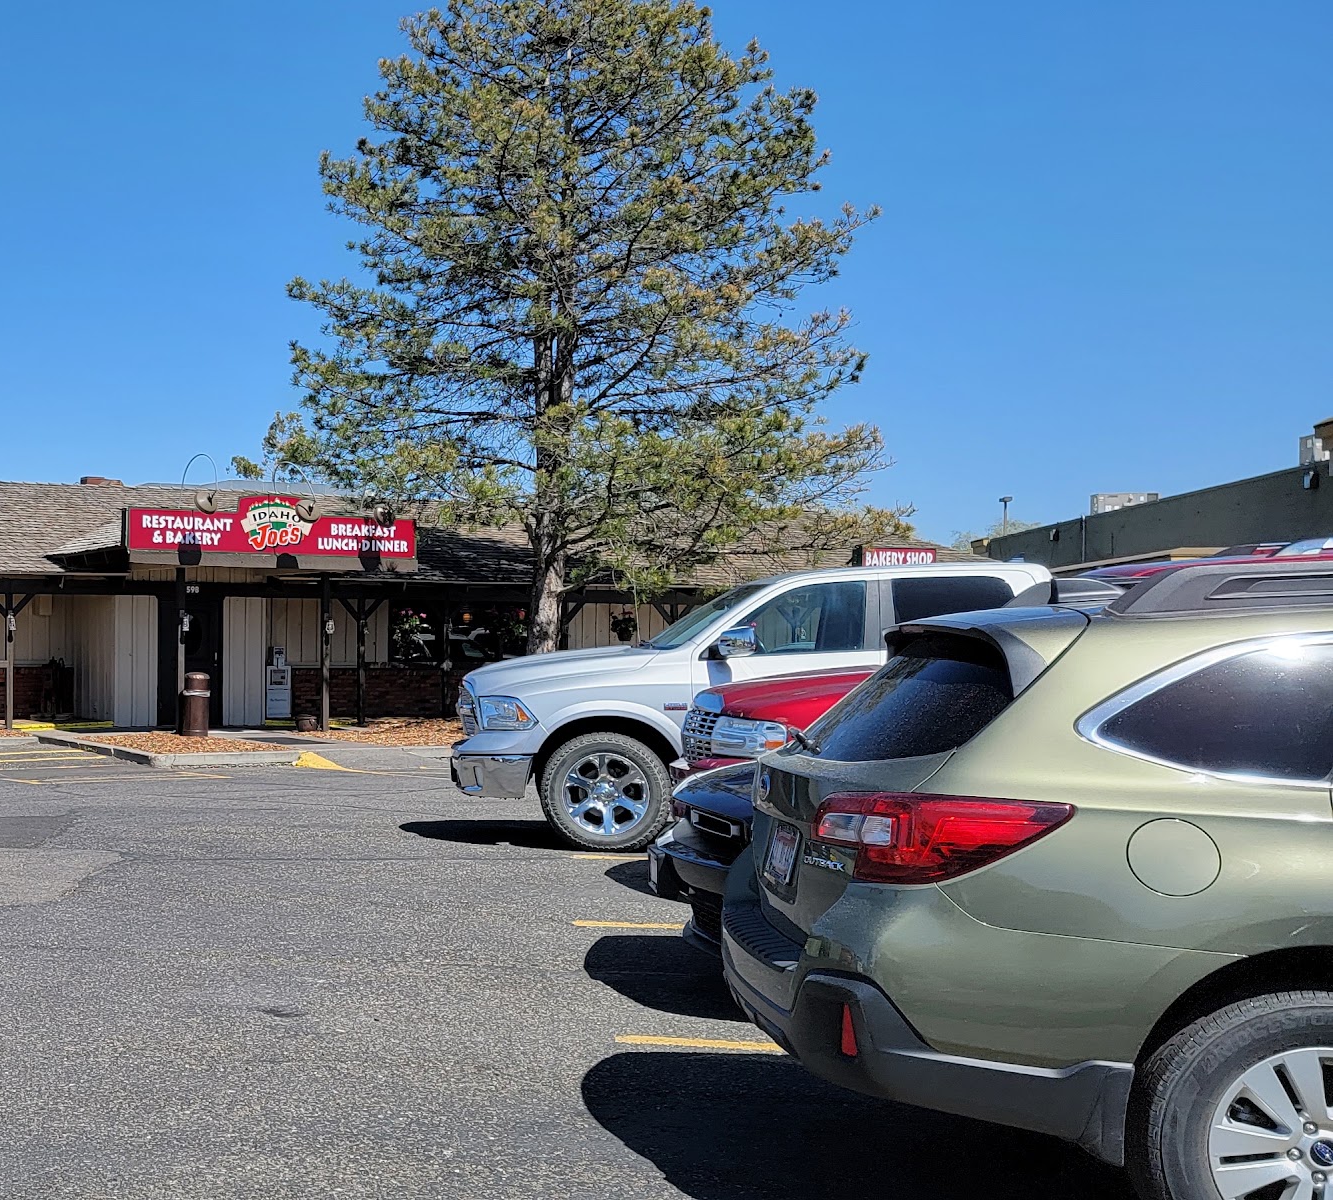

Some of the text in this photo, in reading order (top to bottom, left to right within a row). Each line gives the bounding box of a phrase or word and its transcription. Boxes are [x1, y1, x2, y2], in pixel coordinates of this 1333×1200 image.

[142, 515, 233, 531] RESTAURANT
[252, 510, 301, 523] IDAHO
[152, 530, 221, 545] & BAKERY
[248, 523, 303, 551] Joe's
[330, 523, 396, 538] BREAKFAST
[866, 551, 933, 566] BAKERY SHOP
[186, 585, 199, 593] 598
[803, 855, 845, 872] OUTBACK
